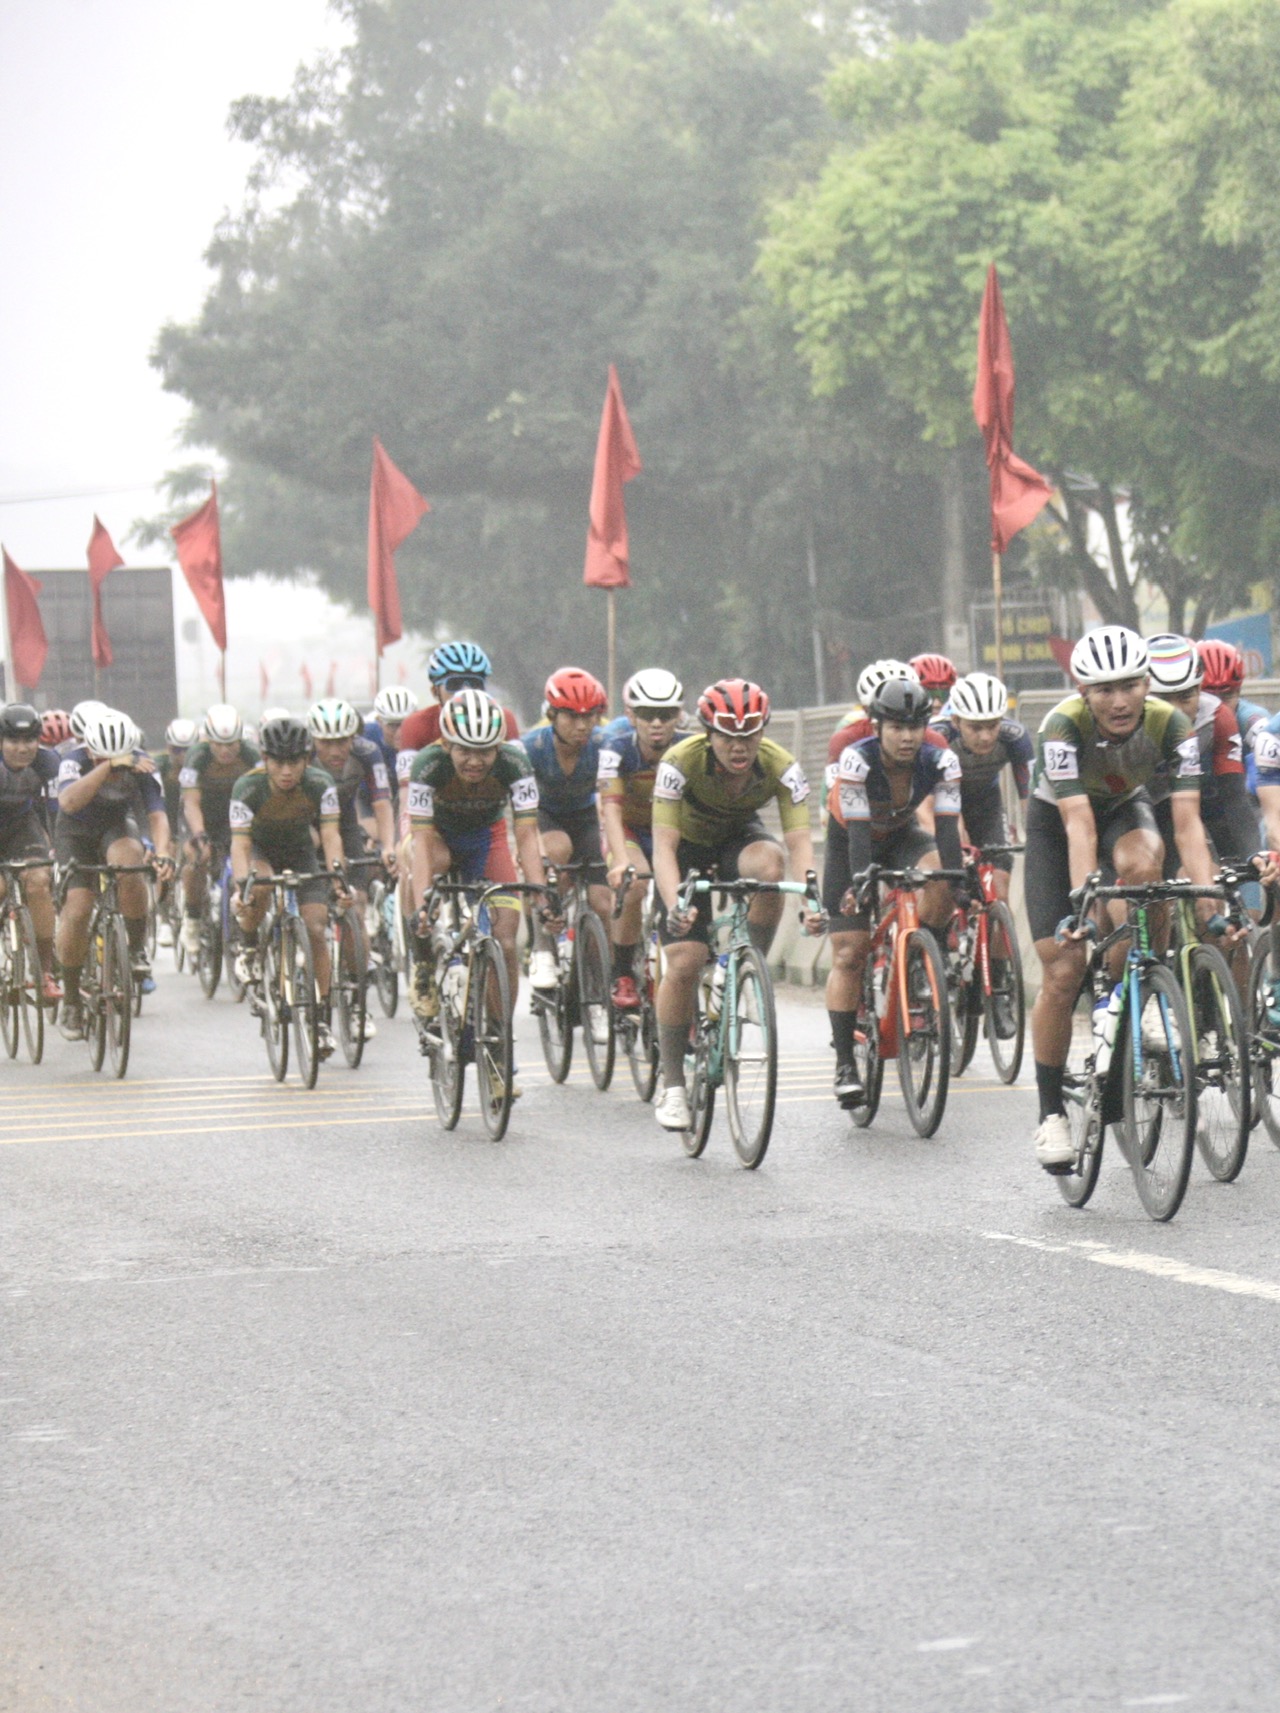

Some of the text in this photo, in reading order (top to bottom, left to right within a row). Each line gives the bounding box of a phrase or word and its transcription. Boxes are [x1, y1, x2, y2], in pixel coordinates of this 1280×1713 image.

[1048, 748, 1069, 770] 32
[410, 789, 430, 808] 56
[519, 784, 537, 802] 56
